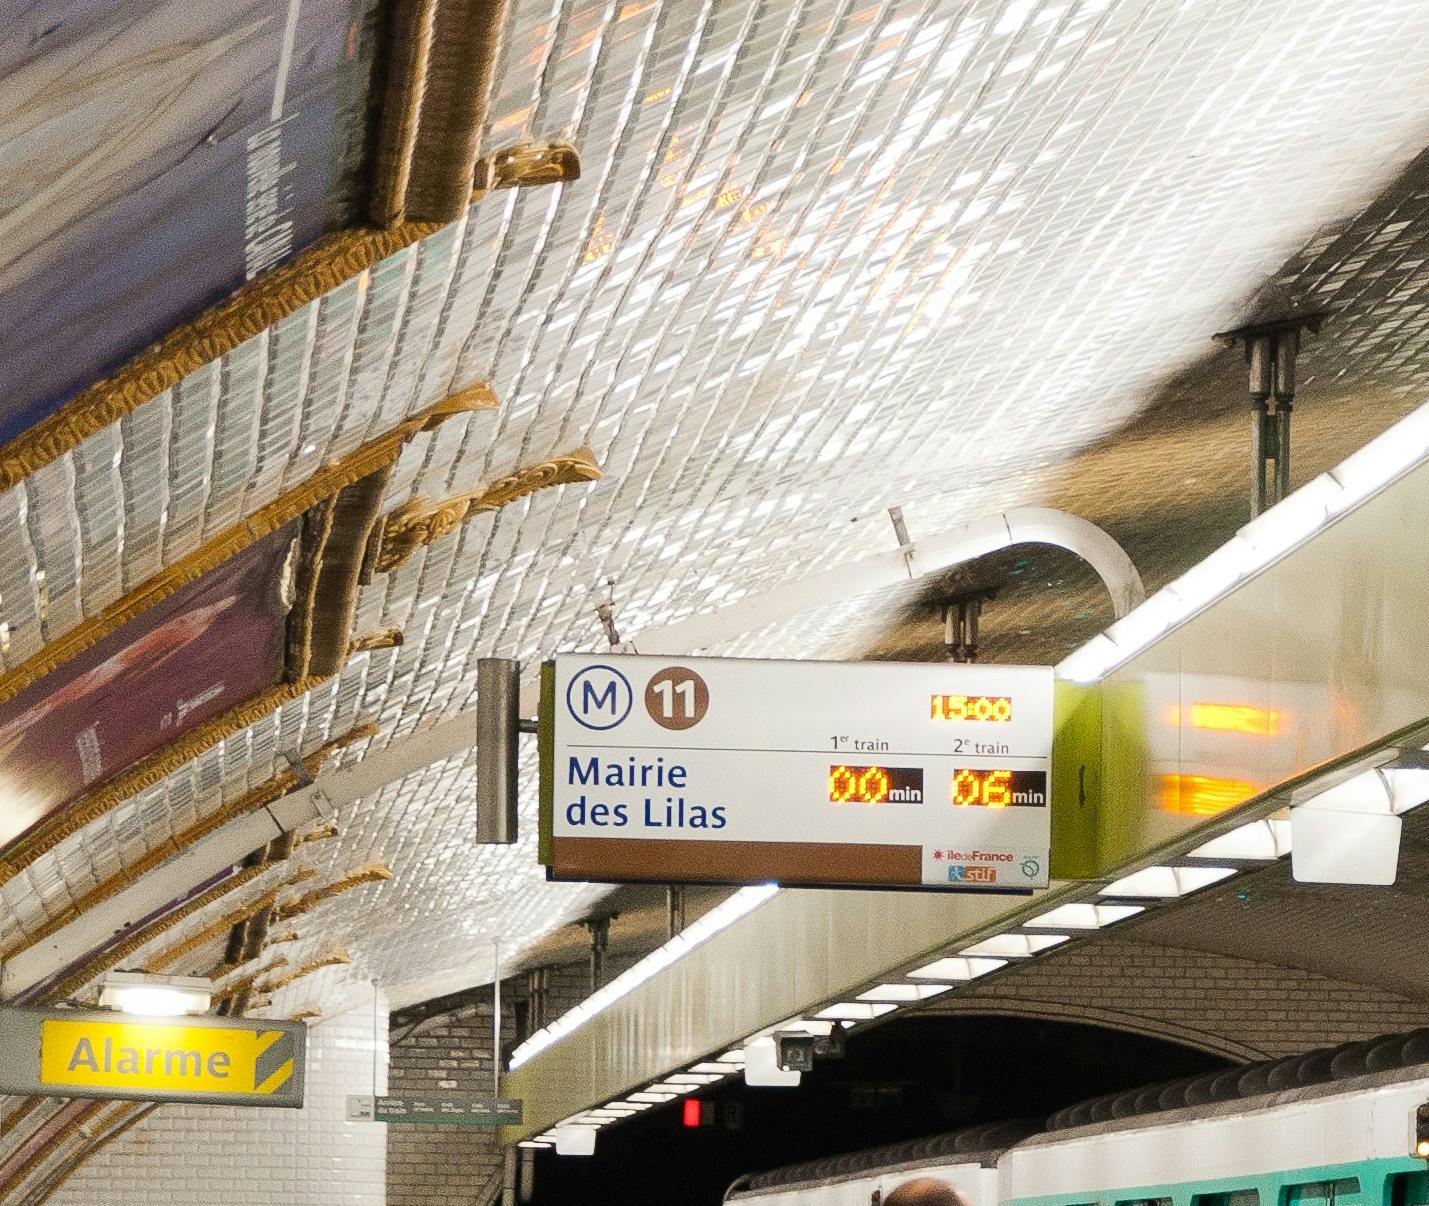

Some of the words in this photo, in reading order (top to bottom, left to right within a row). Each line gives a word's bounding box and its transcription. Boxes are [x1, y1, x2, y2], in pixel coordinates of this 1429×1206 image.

[583, 680, 617, 715] M
[653, 679, 695, 718] 11
[932, 695, 1011, 721] 15:00
[855, 738, 889, 751] train
[953, 738, 970, 753] 2e
[976, 741, 1009, 755] train
[568, 756, 687, 788] Mairie
[828, 765, 888, 804] 00
[889, 786, 922, 801] min
[952, 769, 1012, 809] 06
[1013, 790, 1044, 804] min
[566, 796, 628, 827] des
[644, 797, 727, 829] Lilas
[67, 1036, 231, 1078] Alarme
